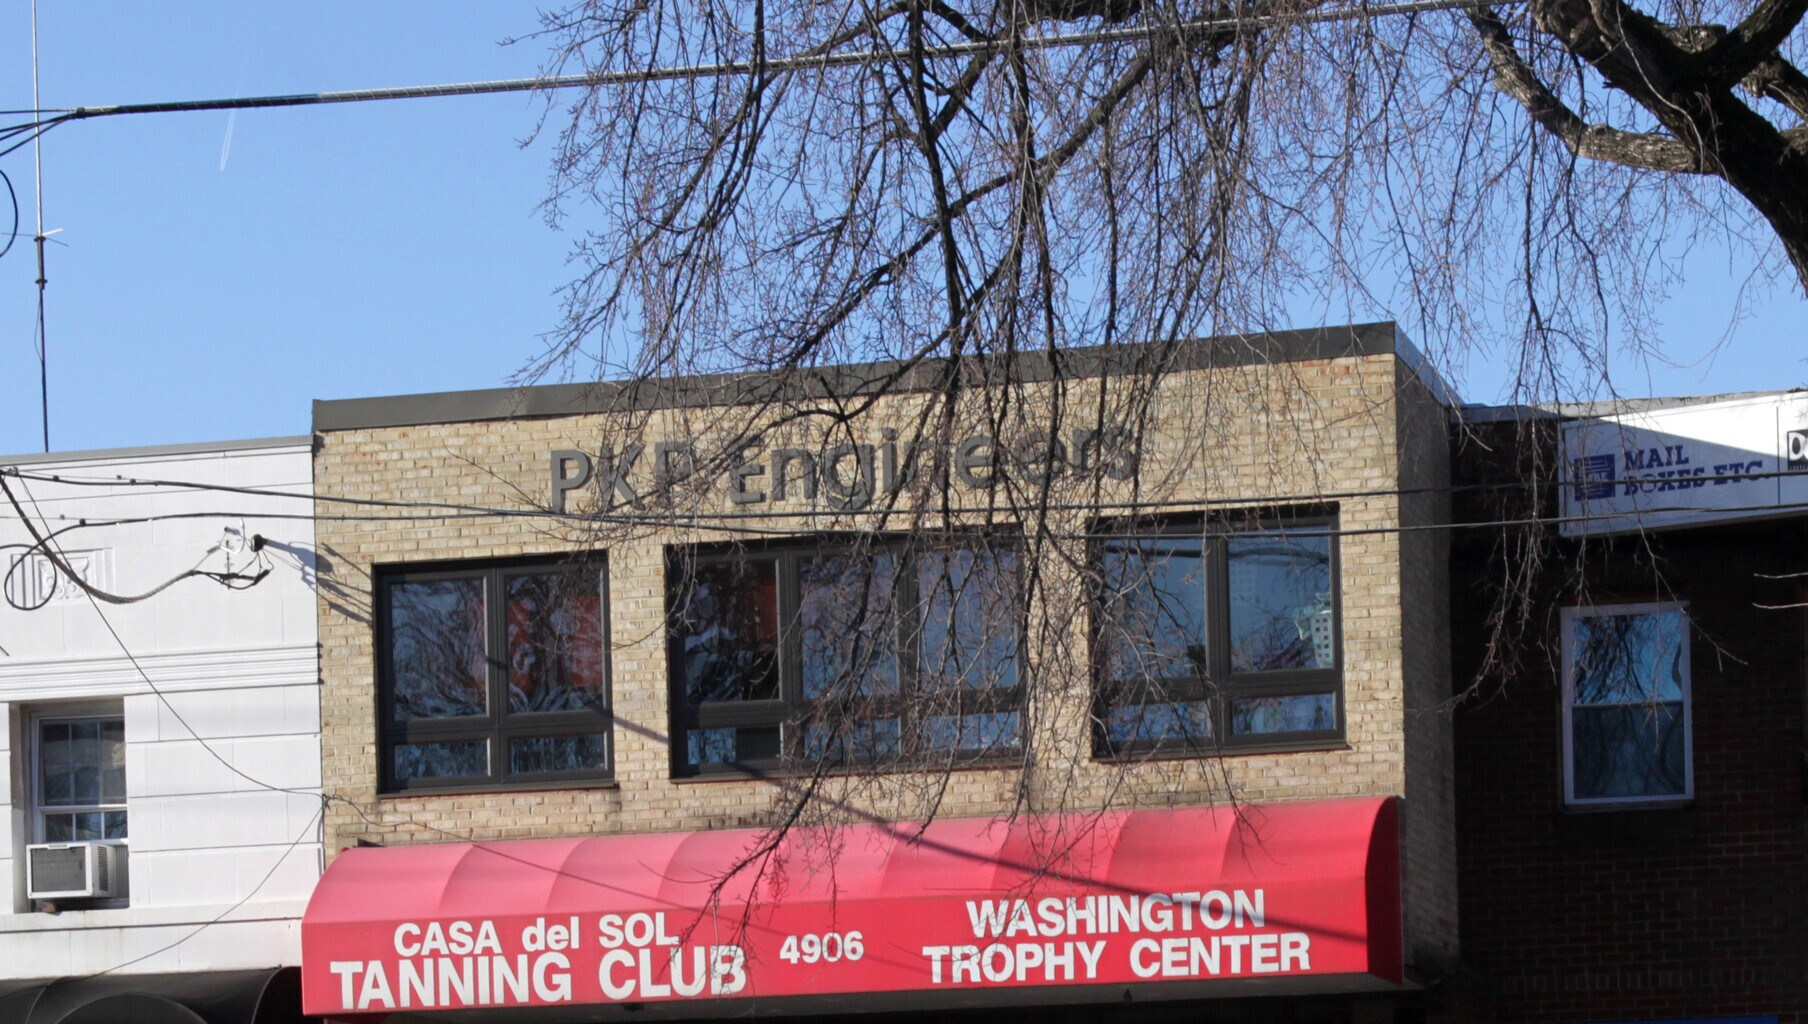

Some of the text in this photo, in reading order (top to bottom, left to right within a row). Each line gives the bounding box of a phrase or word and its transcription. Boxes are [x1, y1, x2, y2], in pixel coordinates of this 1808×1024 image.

[730, 426, 1138, 511] Engineers
[1624, 467, 1705, 496] BOXES
[1625, 445, 1689, 470] MAIL
[394, 912, 680, 957] CASA del SOL
[966, 888, 1266, 939] WASHINGTON
[779, 931, 865, 965] 4906
[922, 932, 1312, 984] TROPHY CENTER
[330, 945, 748, 1010] TANNING CLUB
